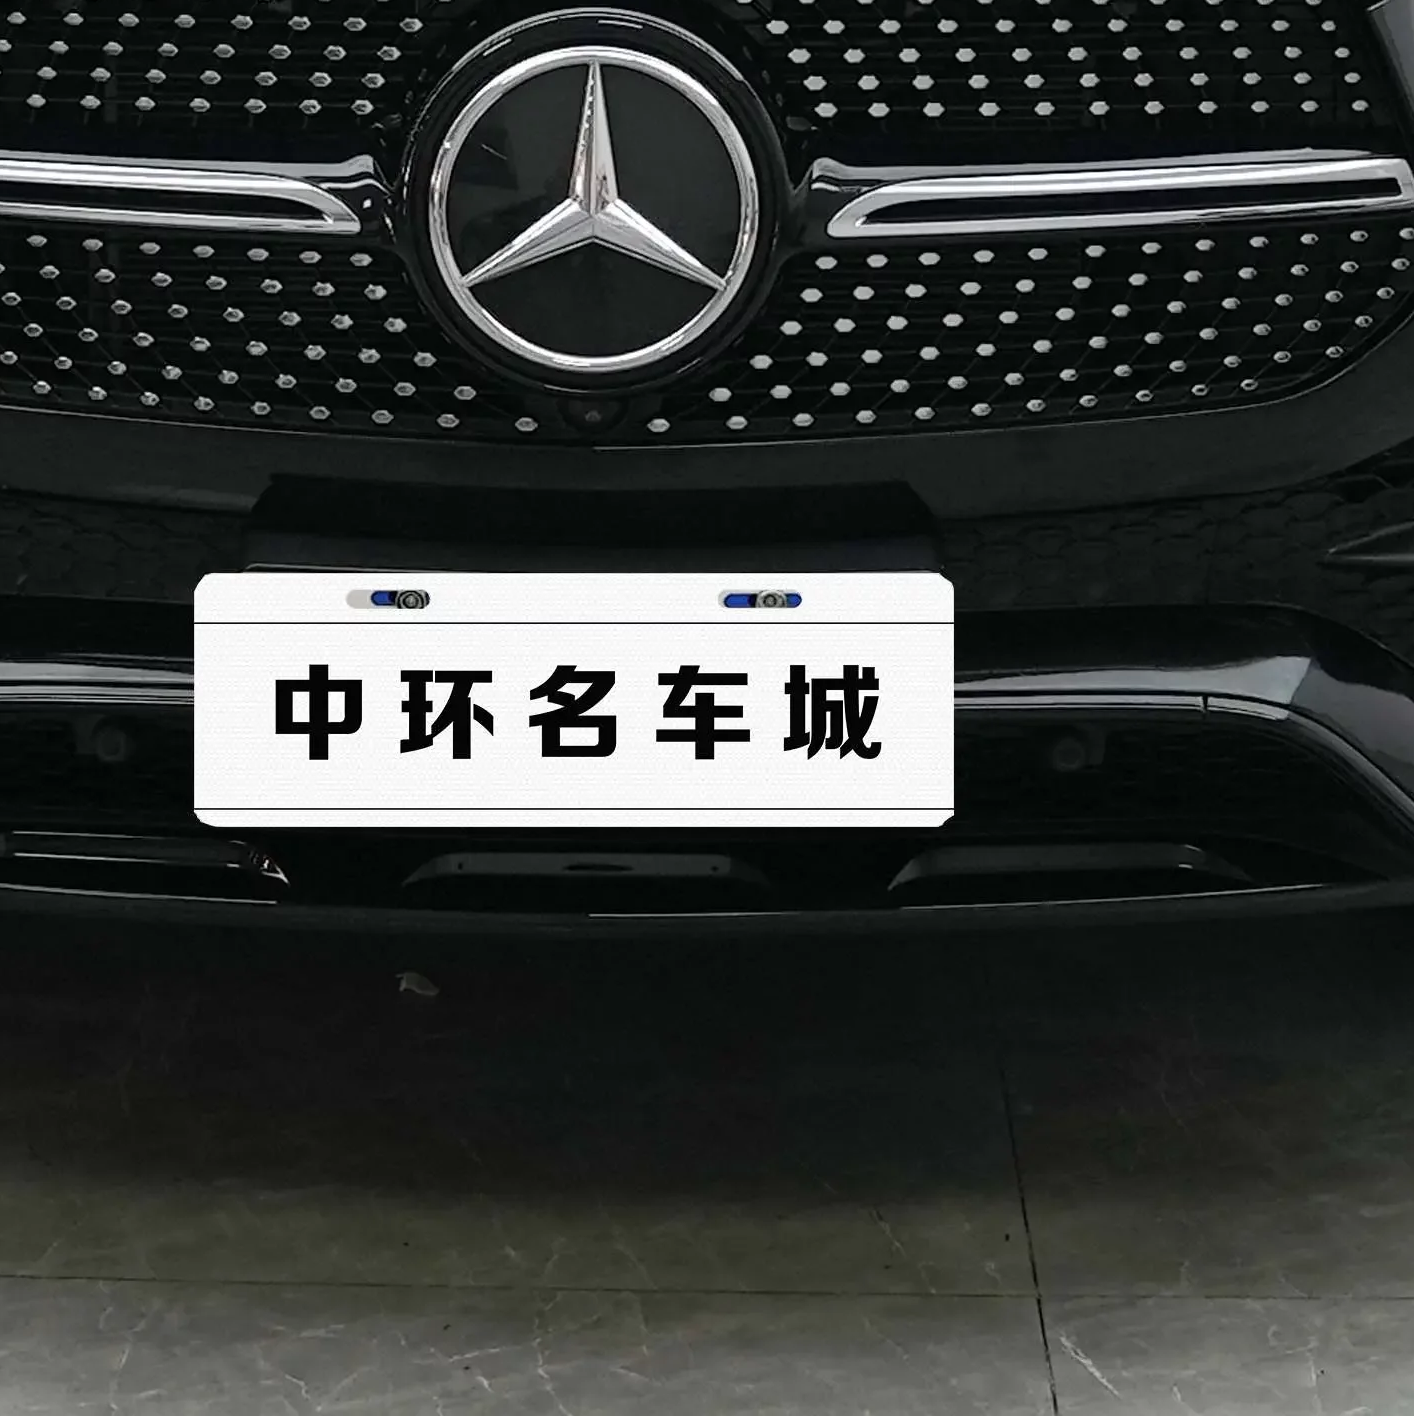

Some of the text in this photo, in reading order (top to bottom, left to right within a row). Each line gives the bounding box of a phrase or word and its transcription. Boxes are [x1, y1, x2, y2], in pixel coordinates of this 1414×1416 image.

[274, 664, 882, 760] 中环名车城
